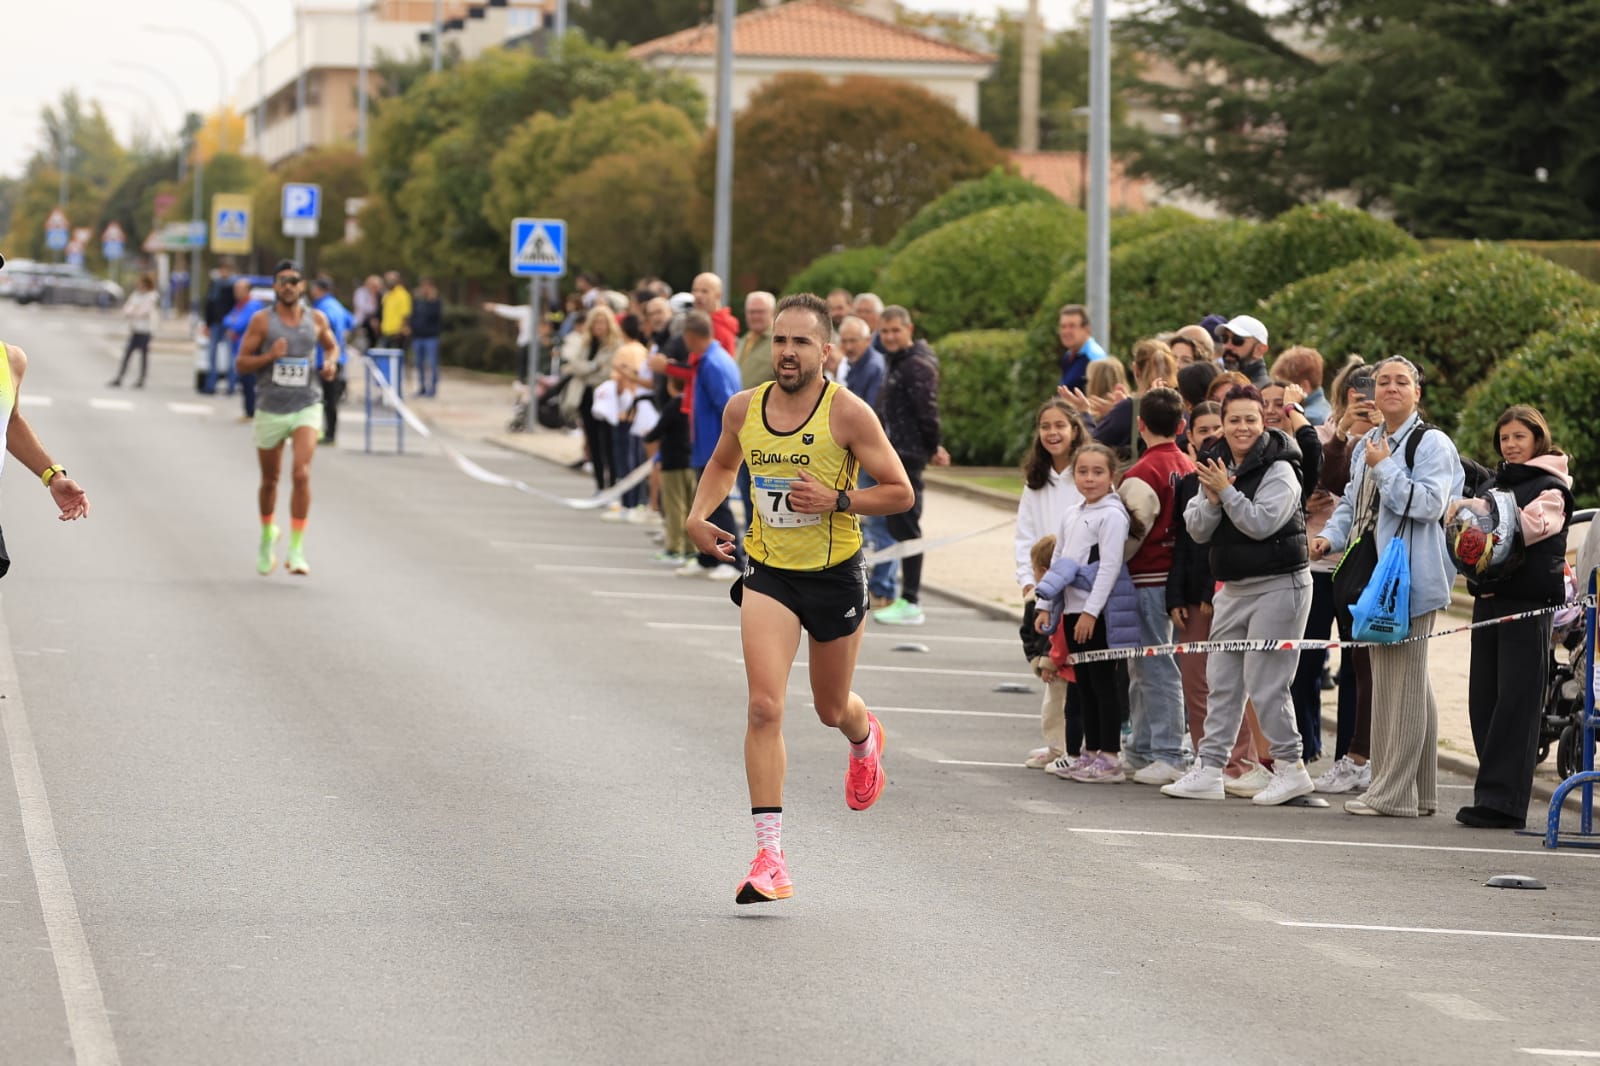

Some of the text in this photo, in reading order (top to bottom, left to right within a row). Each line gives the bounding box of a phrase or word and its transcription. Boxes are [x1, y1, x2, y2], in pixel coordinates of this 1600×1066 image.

[287, 187, 309, 215] P
[751, 449, 781, 465] RUN
[790, 453, 810, 465] GO
